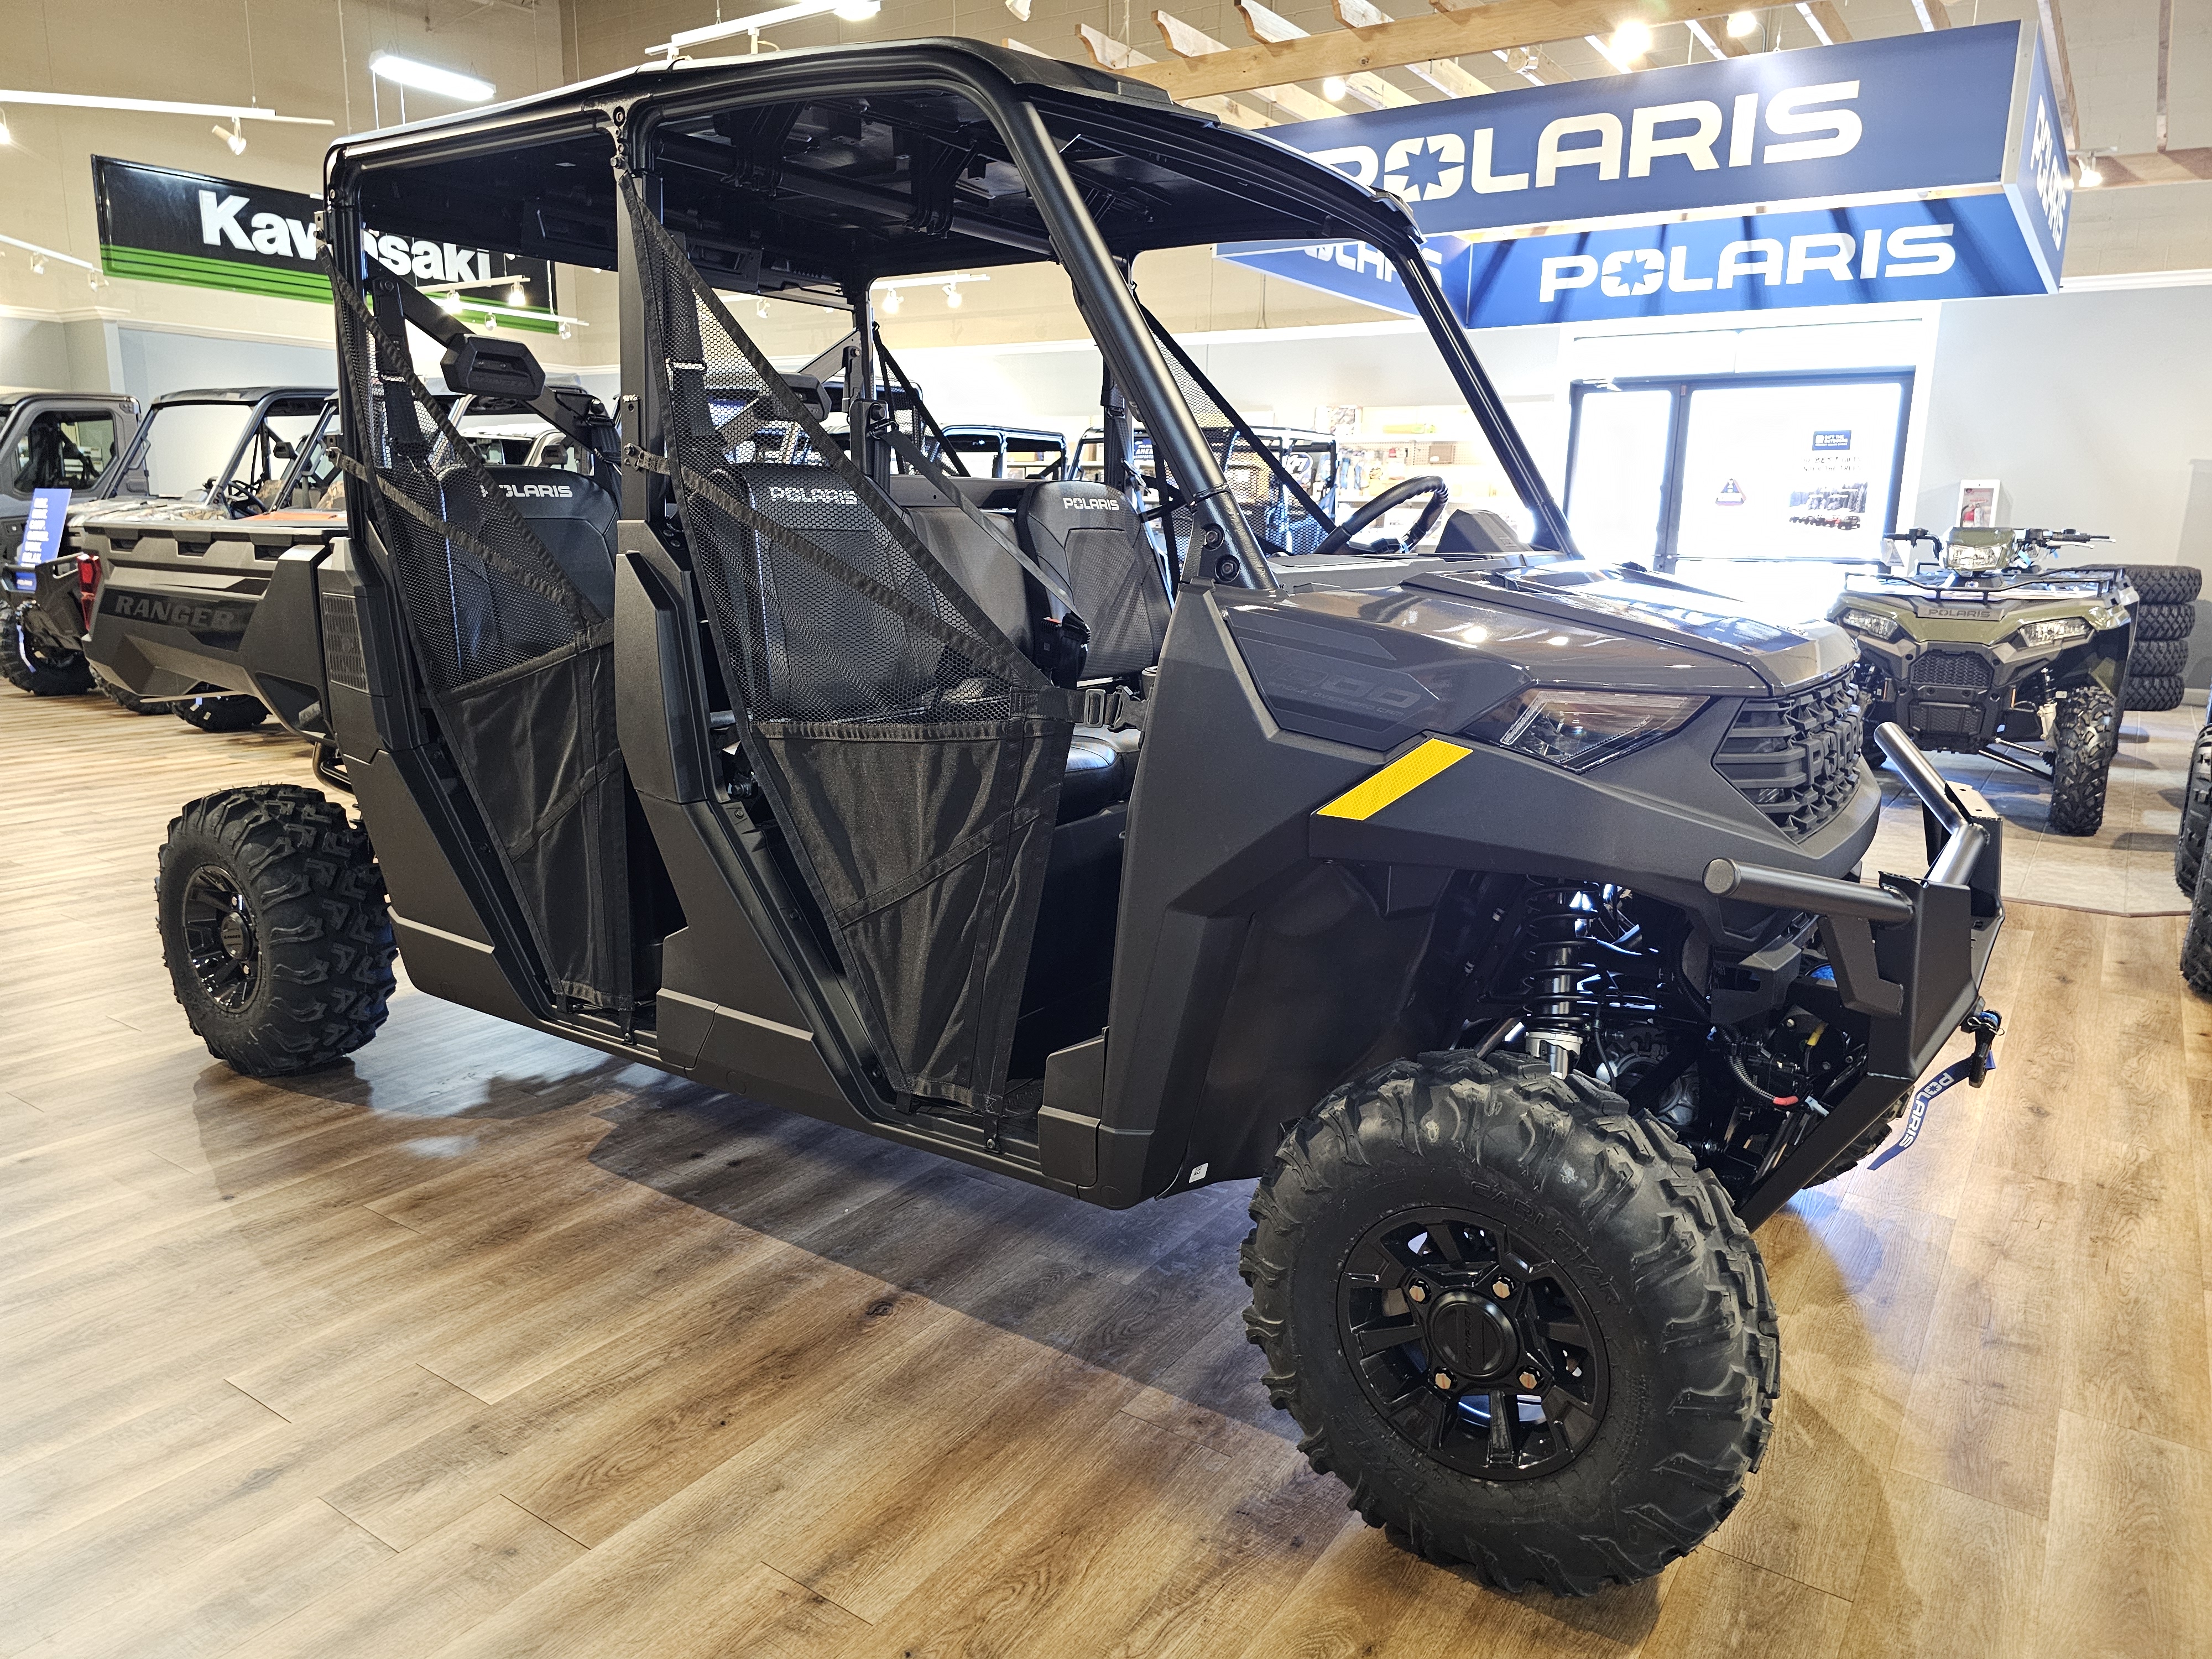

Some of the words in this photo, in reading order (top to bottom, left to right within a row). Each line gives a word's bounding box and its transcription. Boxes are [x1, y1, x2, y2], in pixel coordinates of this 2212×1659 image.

[1309, 80, 1863, 202] POLARIS
[2030, 94, 2068, 252] POLARIS
[1539, 223, 1957, 303] POLARIS
[479, 484, 573, 498] OLARIS
[769, 486, 858, 504] POLARIS
[1063, 497, 1120, 510] POLARIS
[114, 594, 235, 631] RANGER
[1928, 609, 1991, 618] POLARIS
[1898, 1072, 1955, 1149] POLARIS
